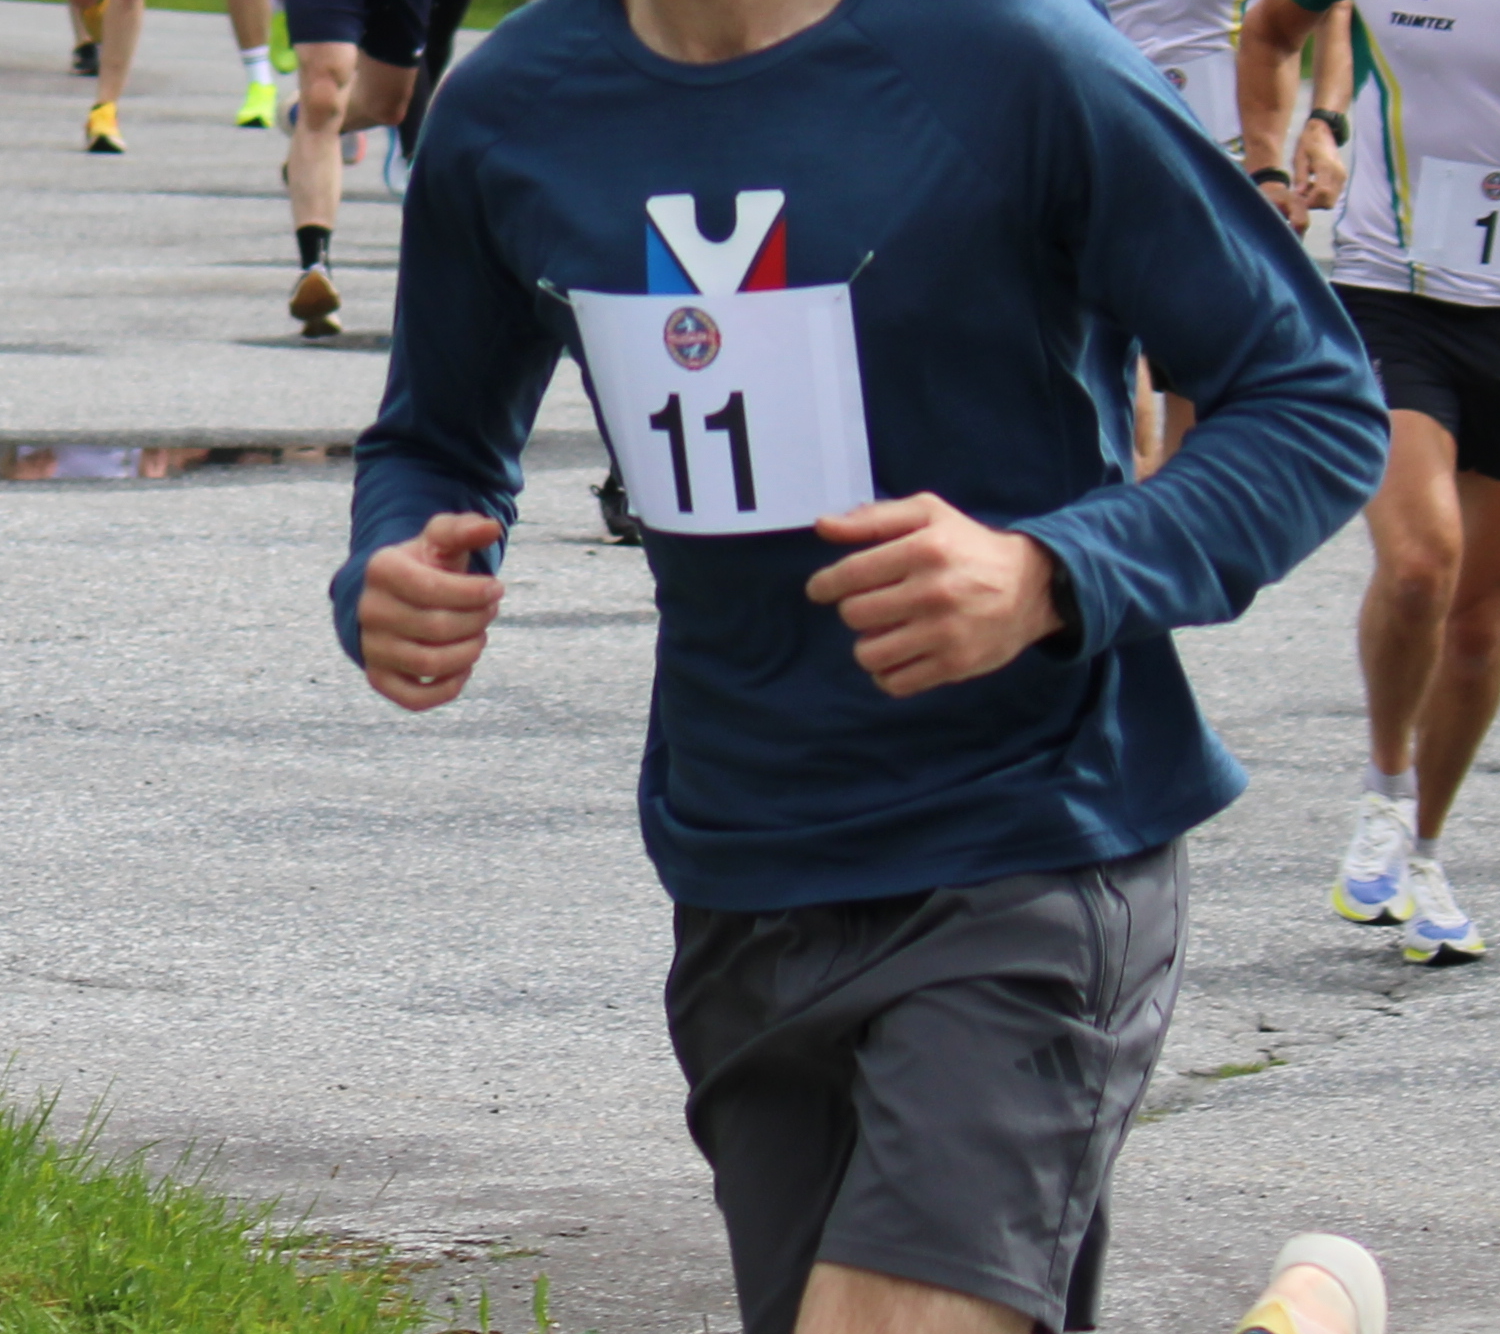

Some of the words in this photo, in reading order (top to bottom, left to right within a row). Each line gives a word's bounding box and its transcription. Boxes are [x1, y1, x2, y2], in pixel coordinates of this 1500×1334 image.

[1389, 11, 1457, 32] TRIMTEX
[1475, 210, 1499, 264] 1
[649, 391, 757, 513] 11
